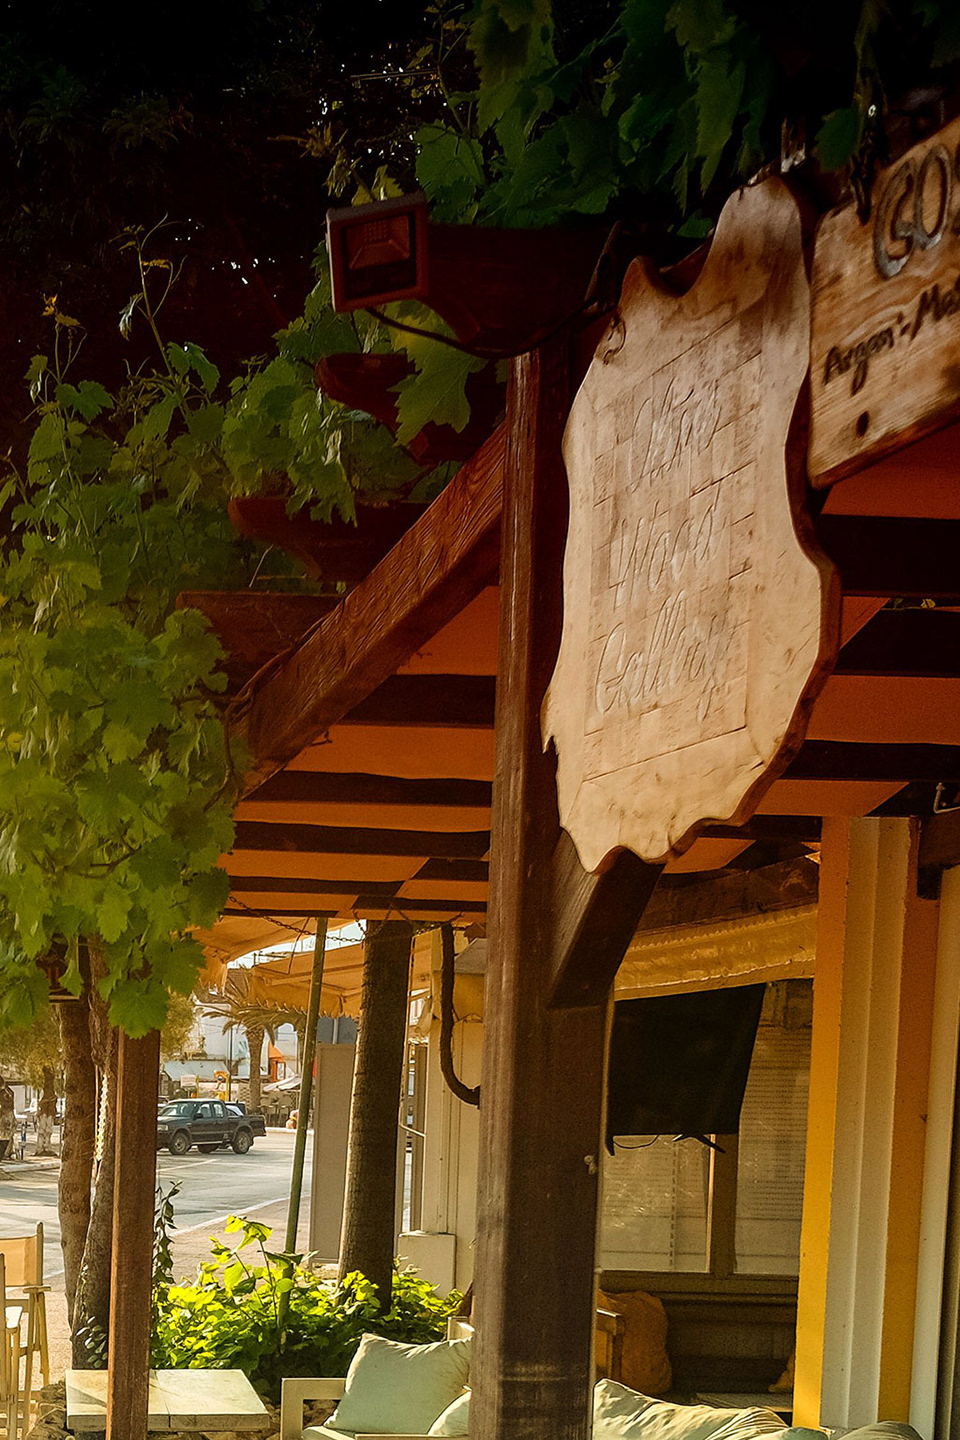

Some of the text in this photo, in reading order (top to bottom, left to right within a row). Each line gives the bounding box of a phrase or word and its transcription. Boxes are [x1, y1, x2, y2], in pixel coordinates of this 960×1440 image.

[873, 141, 960, 272] GO
[612, 478, 729, 612] Wood
[595, 588, 737, 723] Gallery
